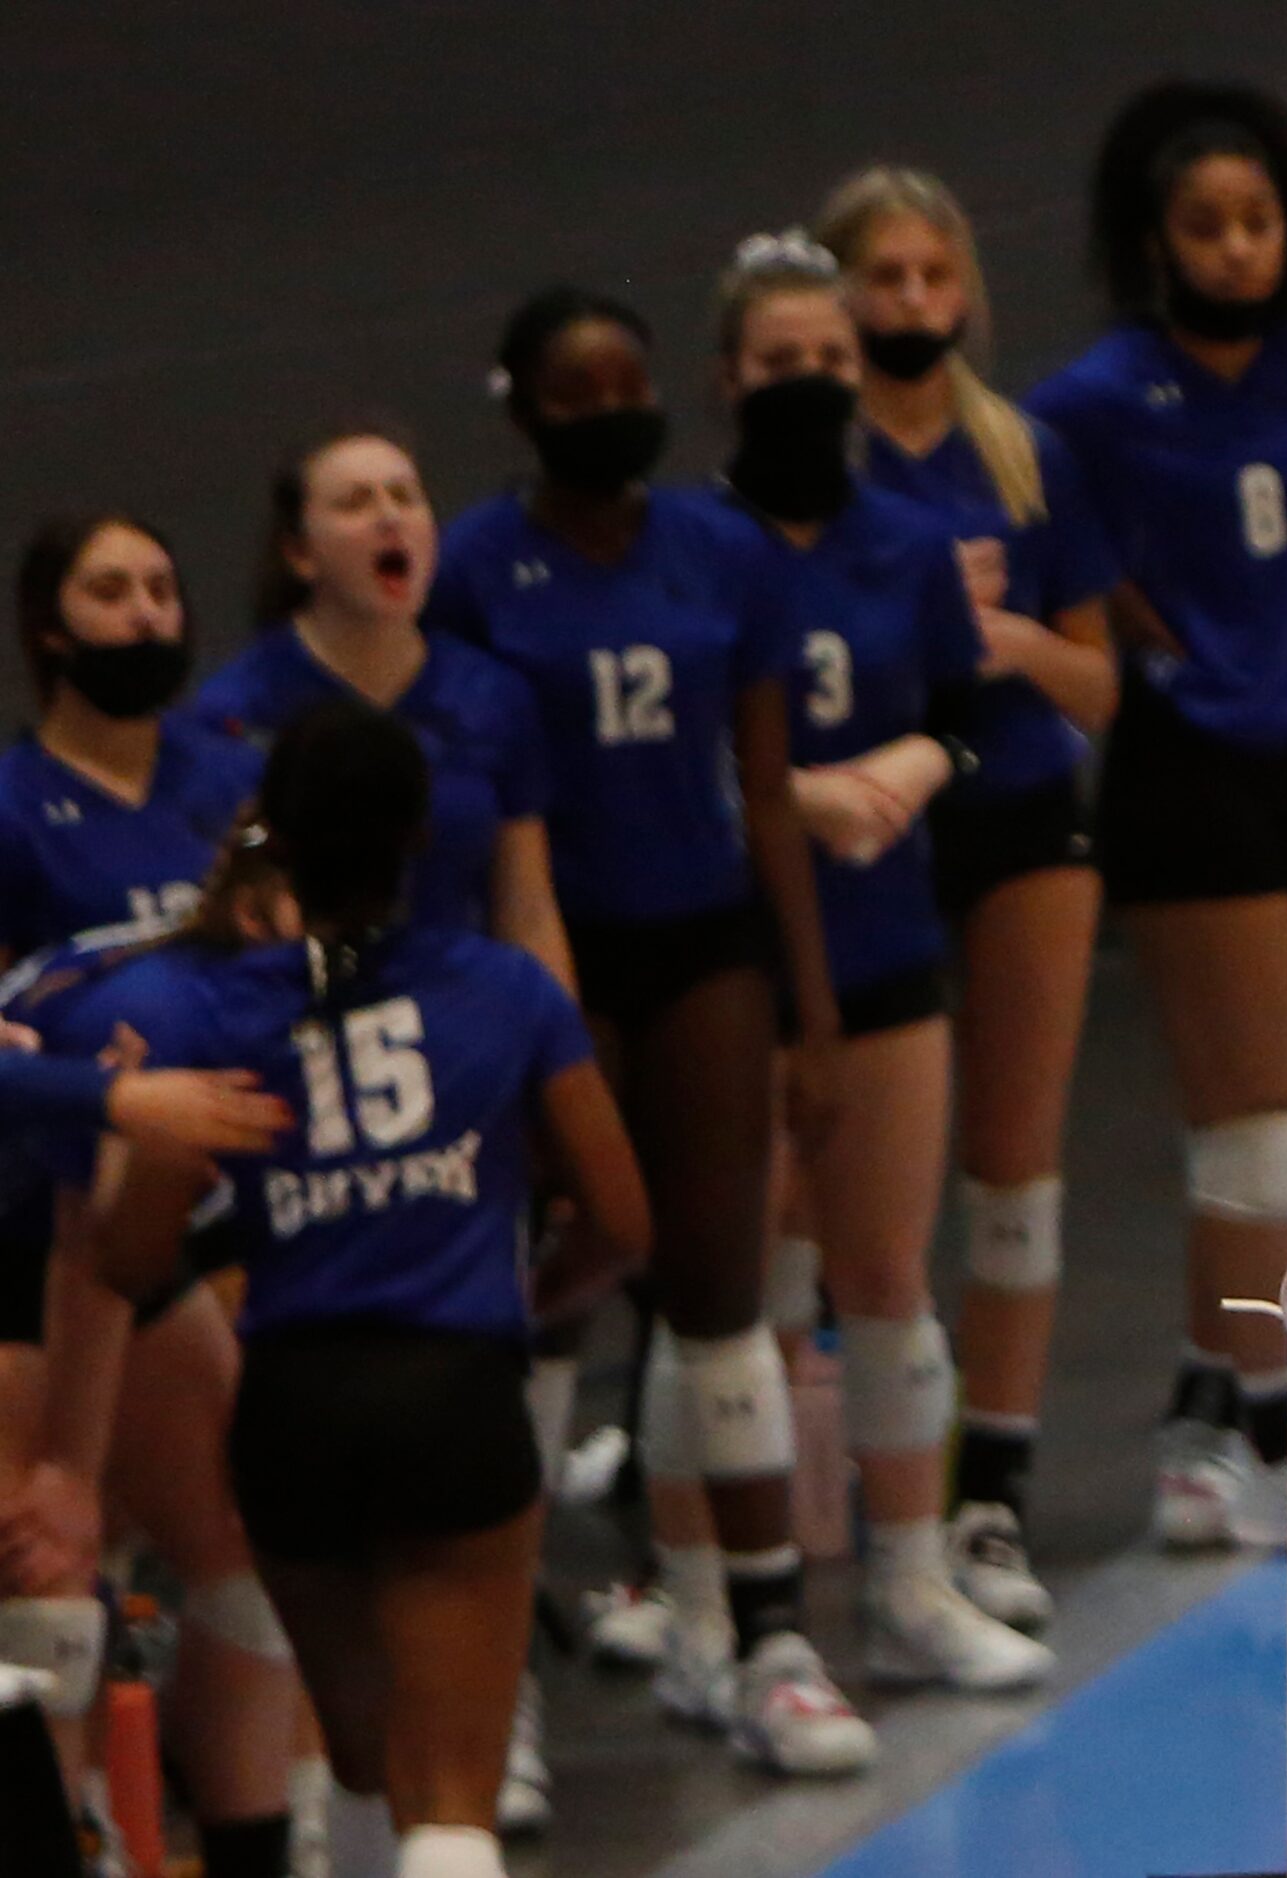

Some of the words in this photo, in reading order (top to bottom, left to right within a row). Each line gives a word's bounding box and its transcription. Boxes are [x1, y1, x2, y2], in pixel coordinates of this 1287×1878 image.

[590, 645, 674, 746] 12
[803, 630, 853, 730] 3
[290, 996, 435, 1157] 15
